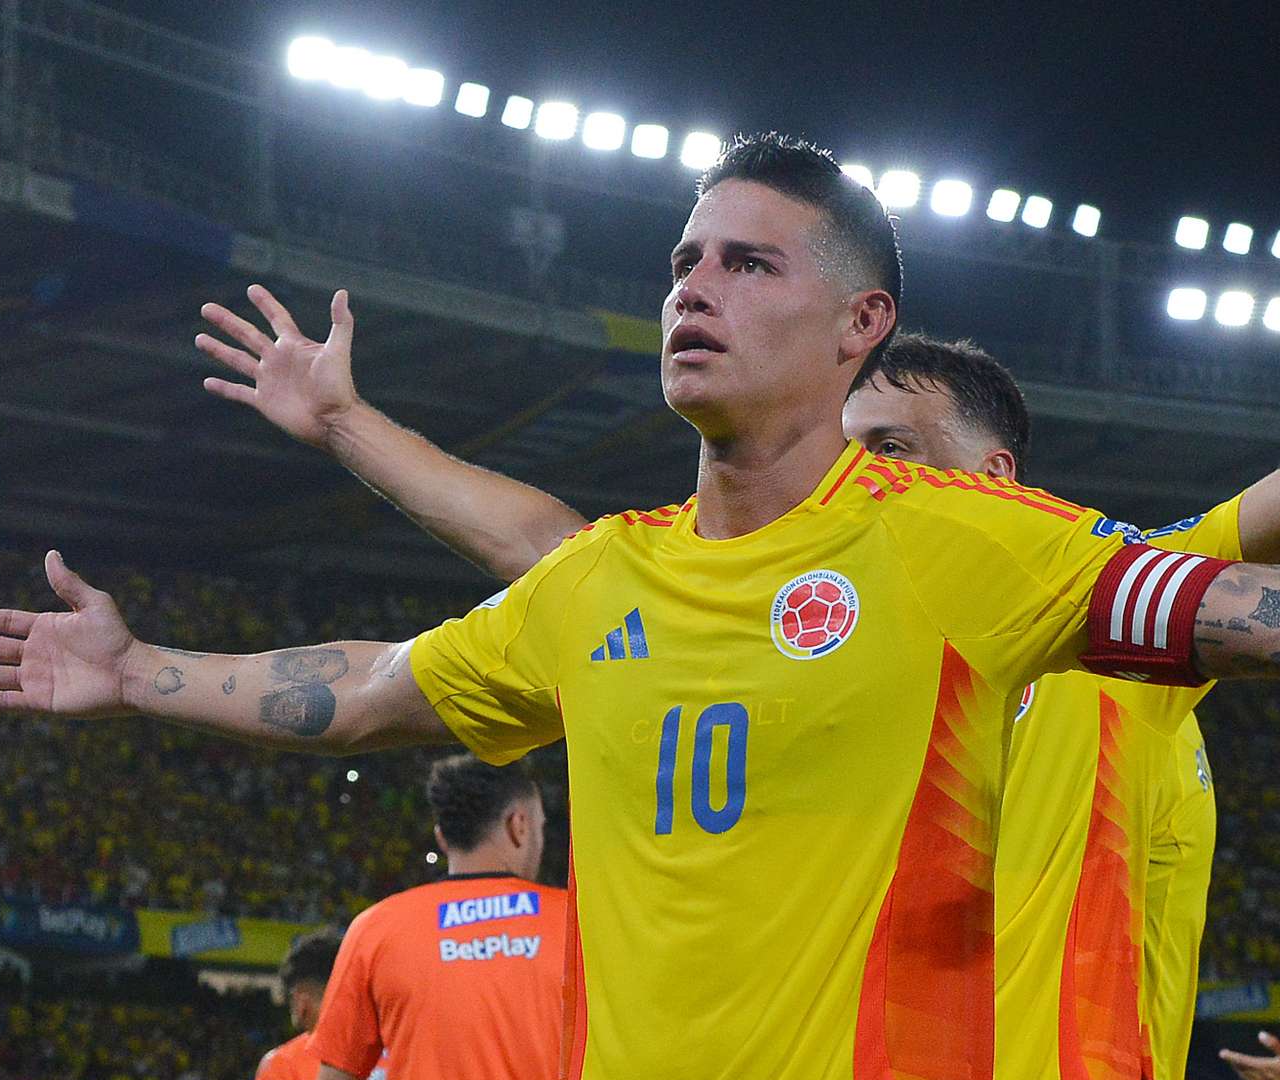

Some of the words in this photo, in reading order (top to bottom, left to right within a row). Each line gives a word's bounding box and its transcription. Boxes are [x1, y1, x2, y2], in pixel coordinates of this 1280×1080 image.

[654, 701, 749, 835] 10
[442, 891, 535, 929] AGUILA
[439, 931, 541, 962] BetPlay
